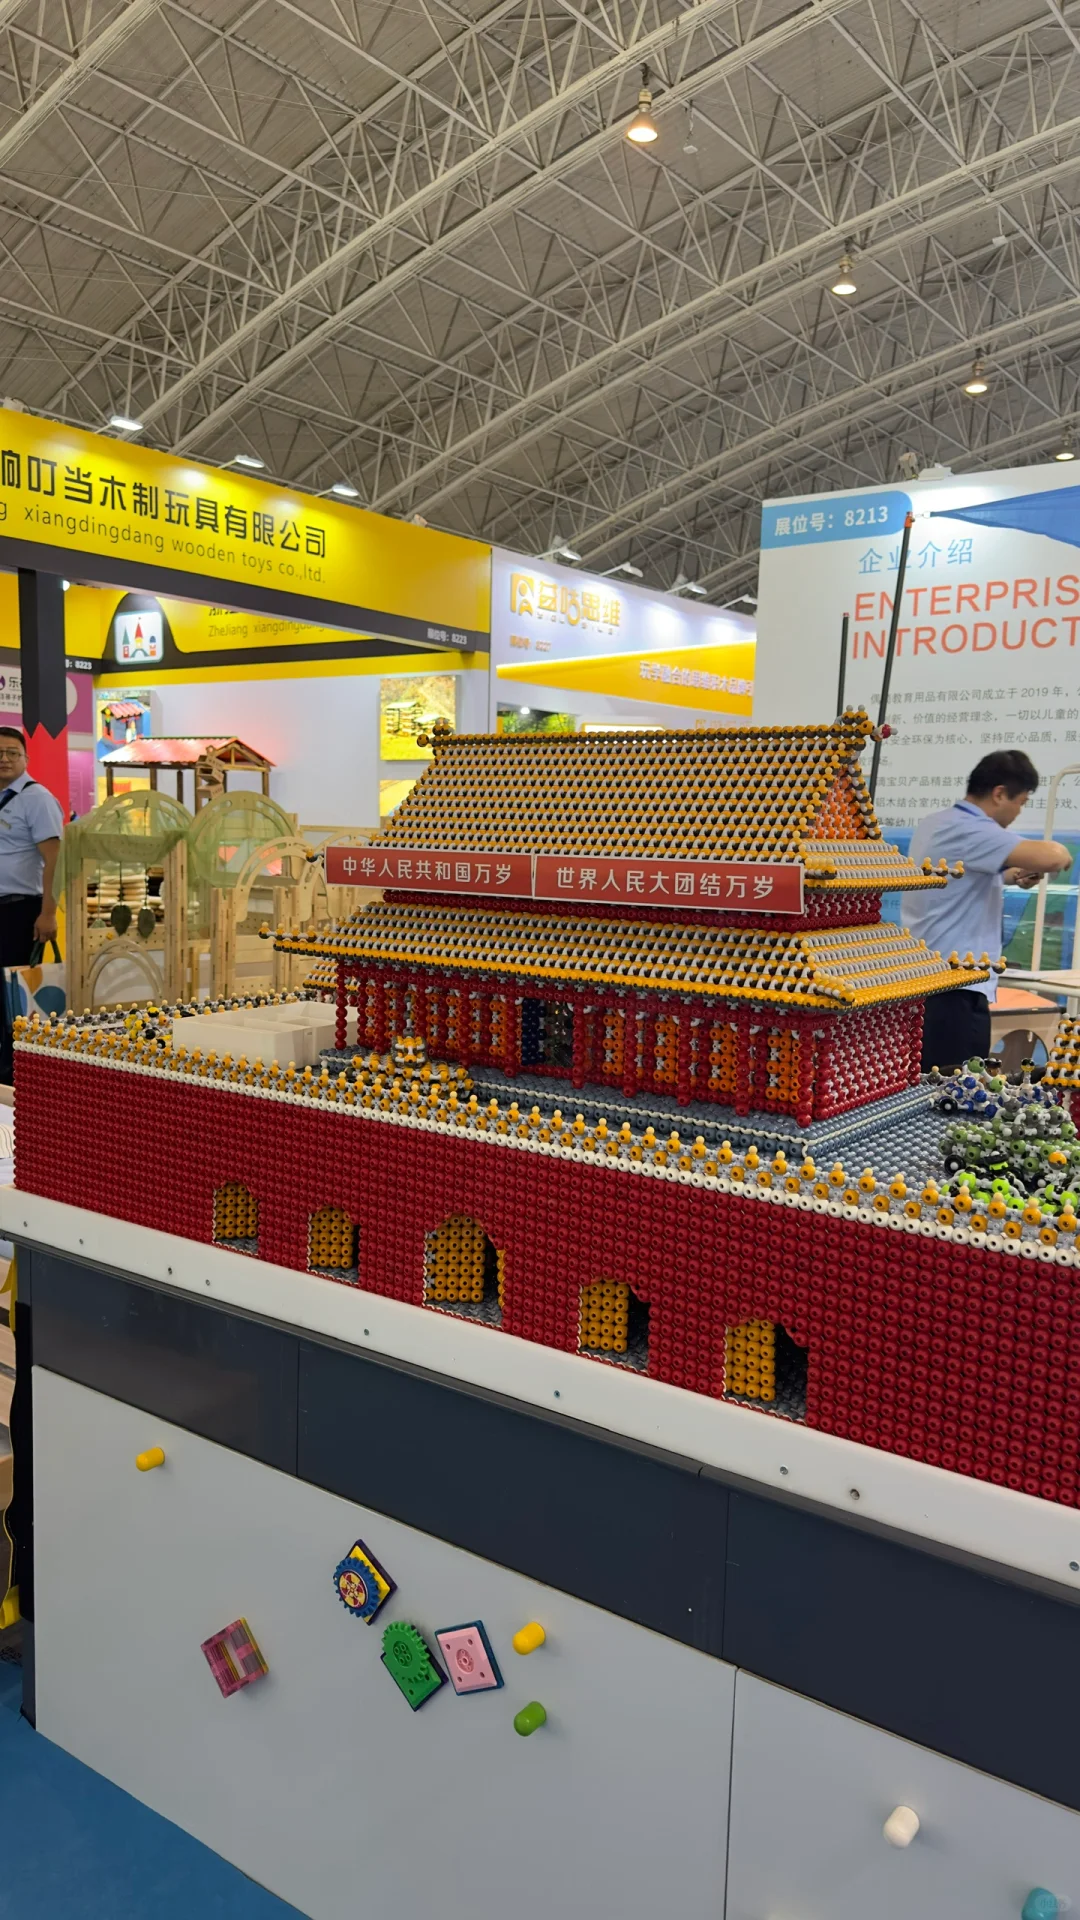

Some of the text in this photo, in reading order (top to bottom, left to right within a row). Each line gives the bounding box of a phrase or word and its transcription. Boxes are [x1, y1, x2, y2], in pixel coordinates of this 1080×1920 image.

[24, 504, 164, 553] xiangdingdang
[171, 538, 236, 563] wooden
[242, 551, 272, 574] toys
[858, 538, 974, 575] 企业介绍
[342, 856, 512, 885] 中华人民共和国万岁
[556, 866, 774, 900] 世界人民大团结万岁
